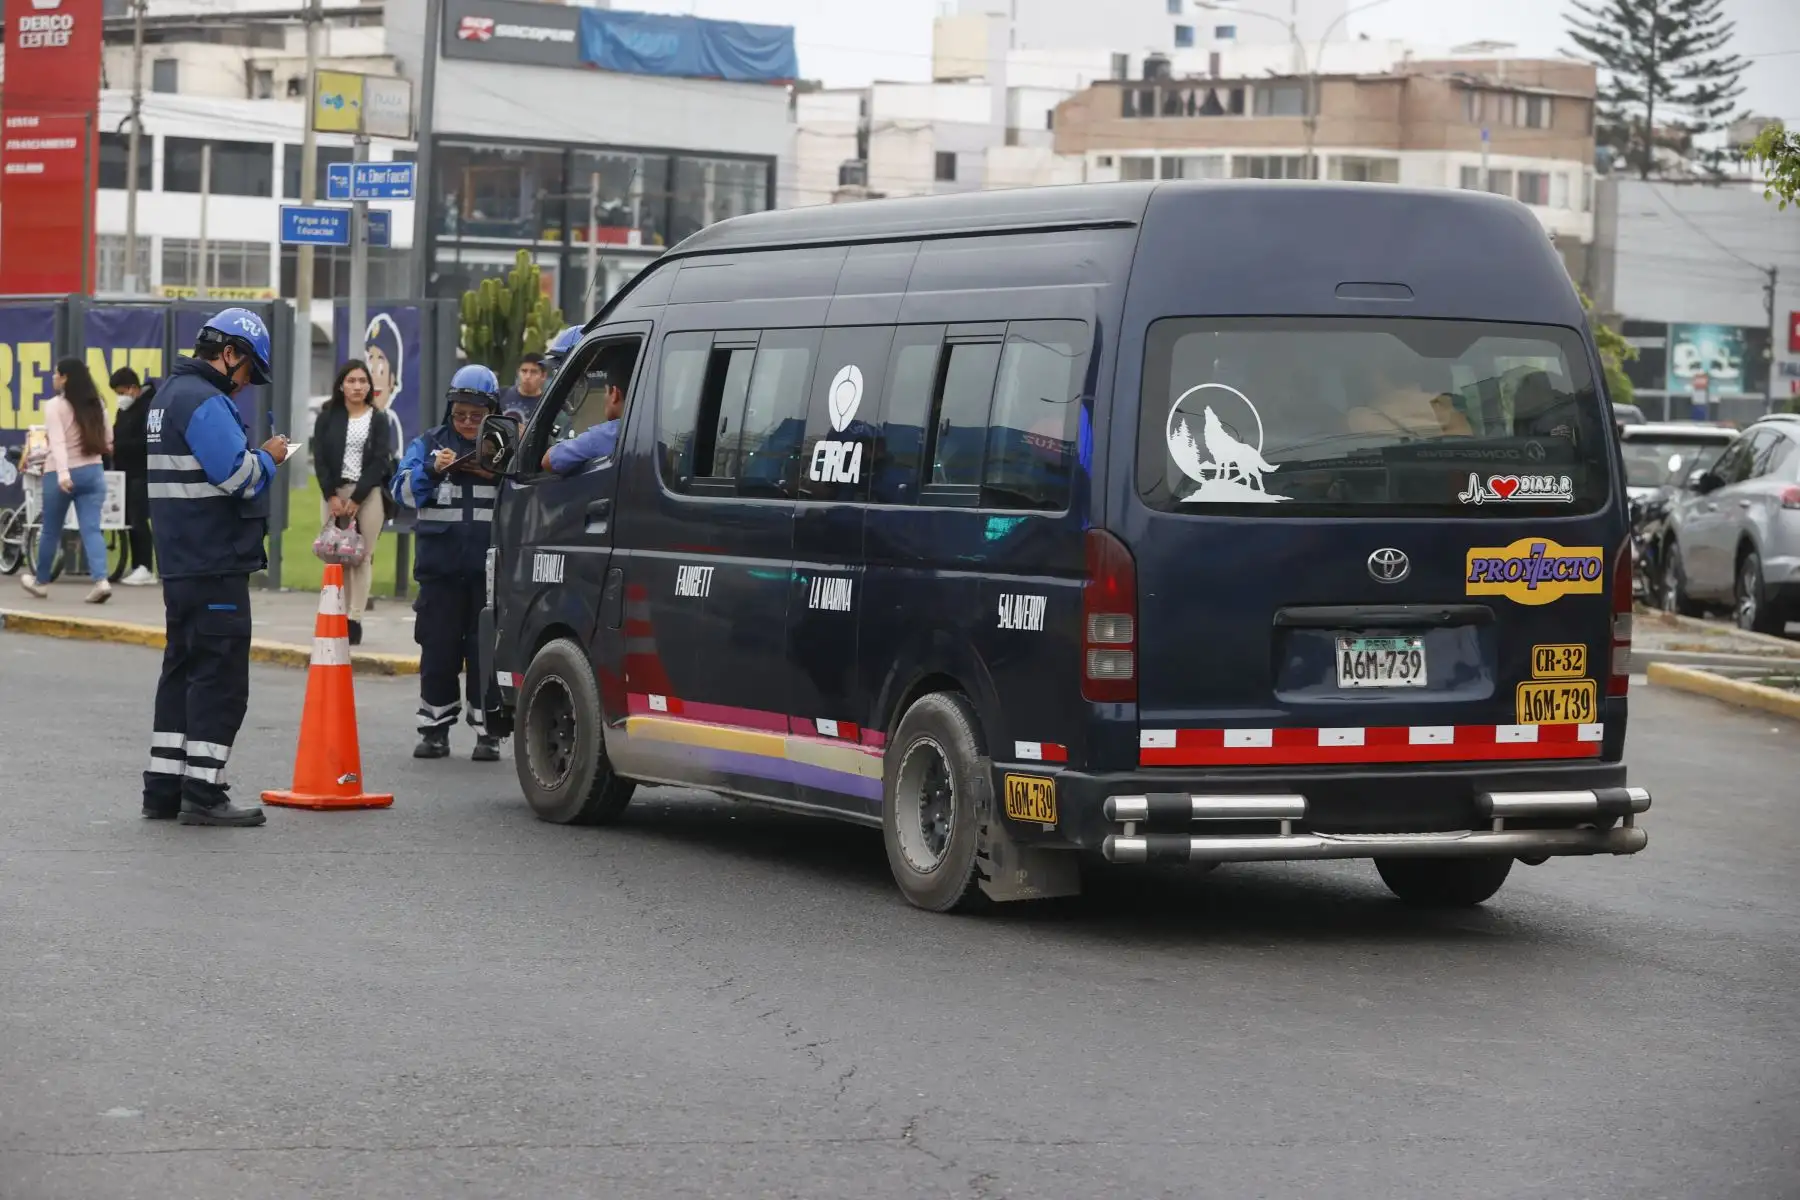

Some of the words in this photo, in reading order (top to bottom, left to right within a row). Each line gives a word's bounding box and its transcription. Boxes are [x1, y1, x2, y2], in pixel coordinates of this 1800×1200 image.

[20, 14, 73, 31] DERCO
[20, 31, 72, 48] center
[357, 169, 367, 184] Av.
[293, 215, 318, 226] Parque
[320, 216, 330, 225] de
[233, 317, 261, 337] ATU
[532, 553, 566, 584] VENTANILLA
[674, 564, 715, 598] FAUCETT
[1468, 556, 1602, 583] PROYECTO
[808, 576, 822, 609] LA
[820, 577, 853, 612] MARINA
[997, 593, 1048, 632] SALAVERRY
[1343, 650, 1422, 680] A6M-739
[1535, 648, 1583, 672] CR-32
[1523, 687, 1591, 722] A6M-739
[1008, 780, 1054, 819] A6M-739
